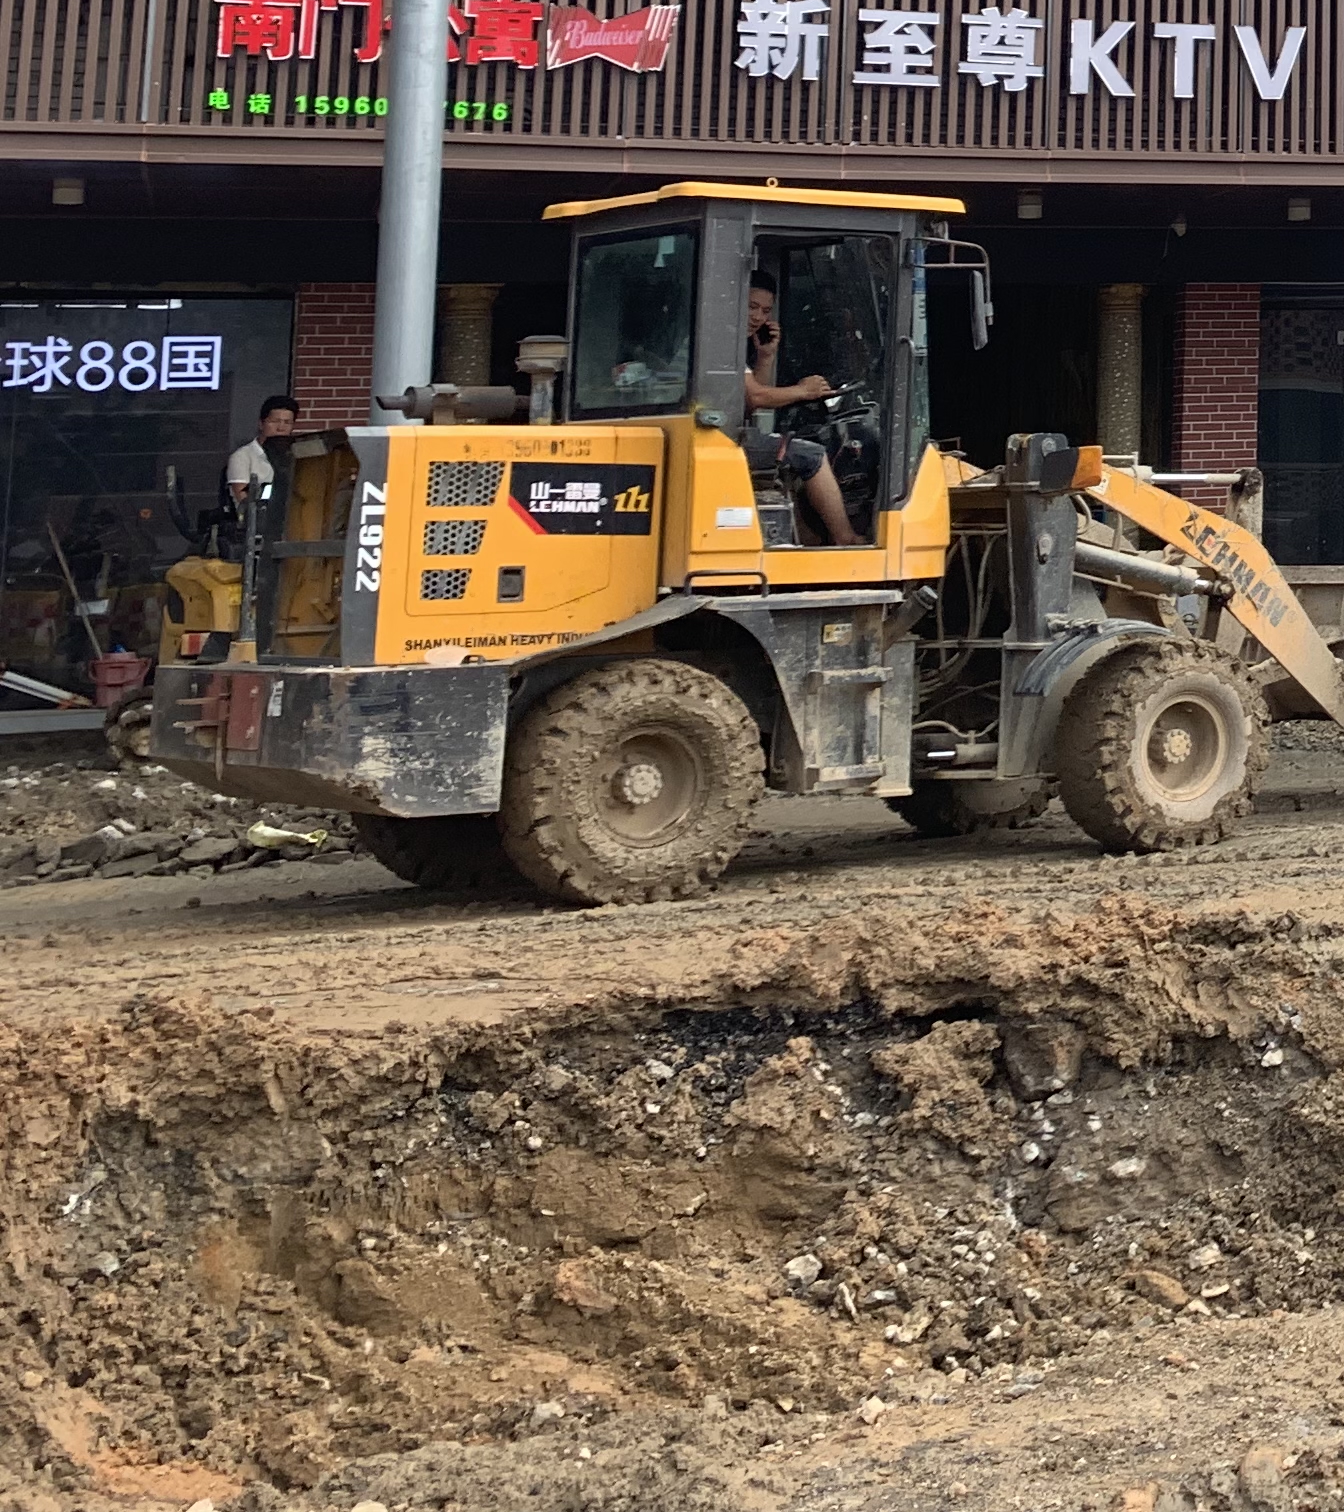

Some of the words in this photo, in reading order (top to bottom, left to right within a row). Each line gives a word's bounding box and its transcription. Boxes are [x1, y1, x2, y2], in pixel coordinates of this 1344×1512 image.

[565, 20, 648, 49] Budweiser
[208, 87, 272, 115] 电话
[294, 95, 509, 121] 15960676
[0, 336, 222, 392] 球88国
[528, 500, 600, 513] LEHMAN
[355, 481, 388, 592] ZL922
[510, 632, 555, 647] HEAVY
